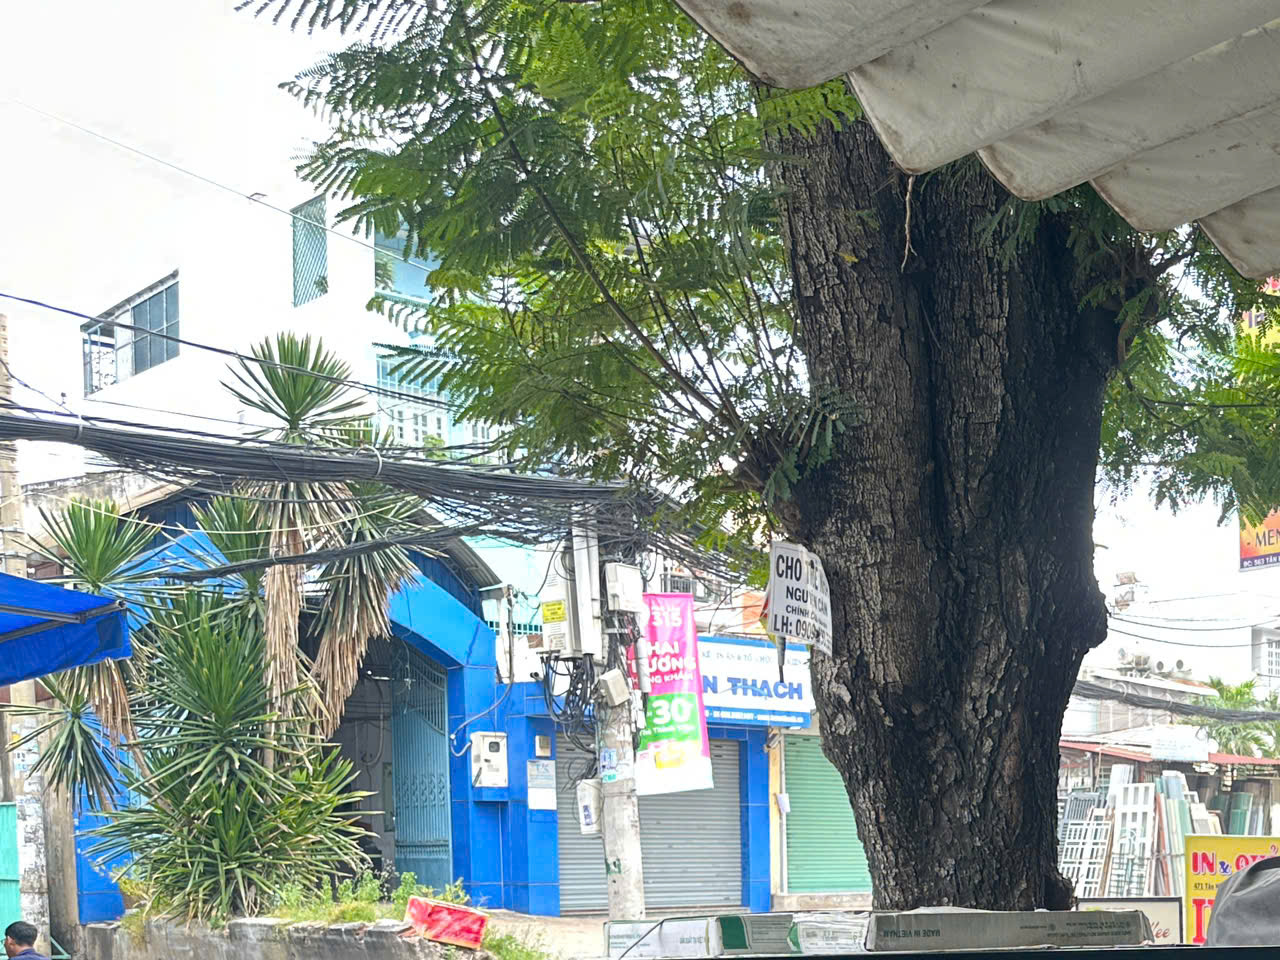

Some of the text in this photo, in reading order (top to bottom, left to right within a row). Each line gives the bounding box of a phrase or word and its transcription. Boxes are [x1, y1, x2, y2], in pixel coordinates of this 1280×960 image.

[776, 554, 802, 582] CHO
[773, 613, 792, 635] LH:
[1192, 851, 1216, 875] IN
[883, 928, 941, 938] MADE IN VIETNAM
